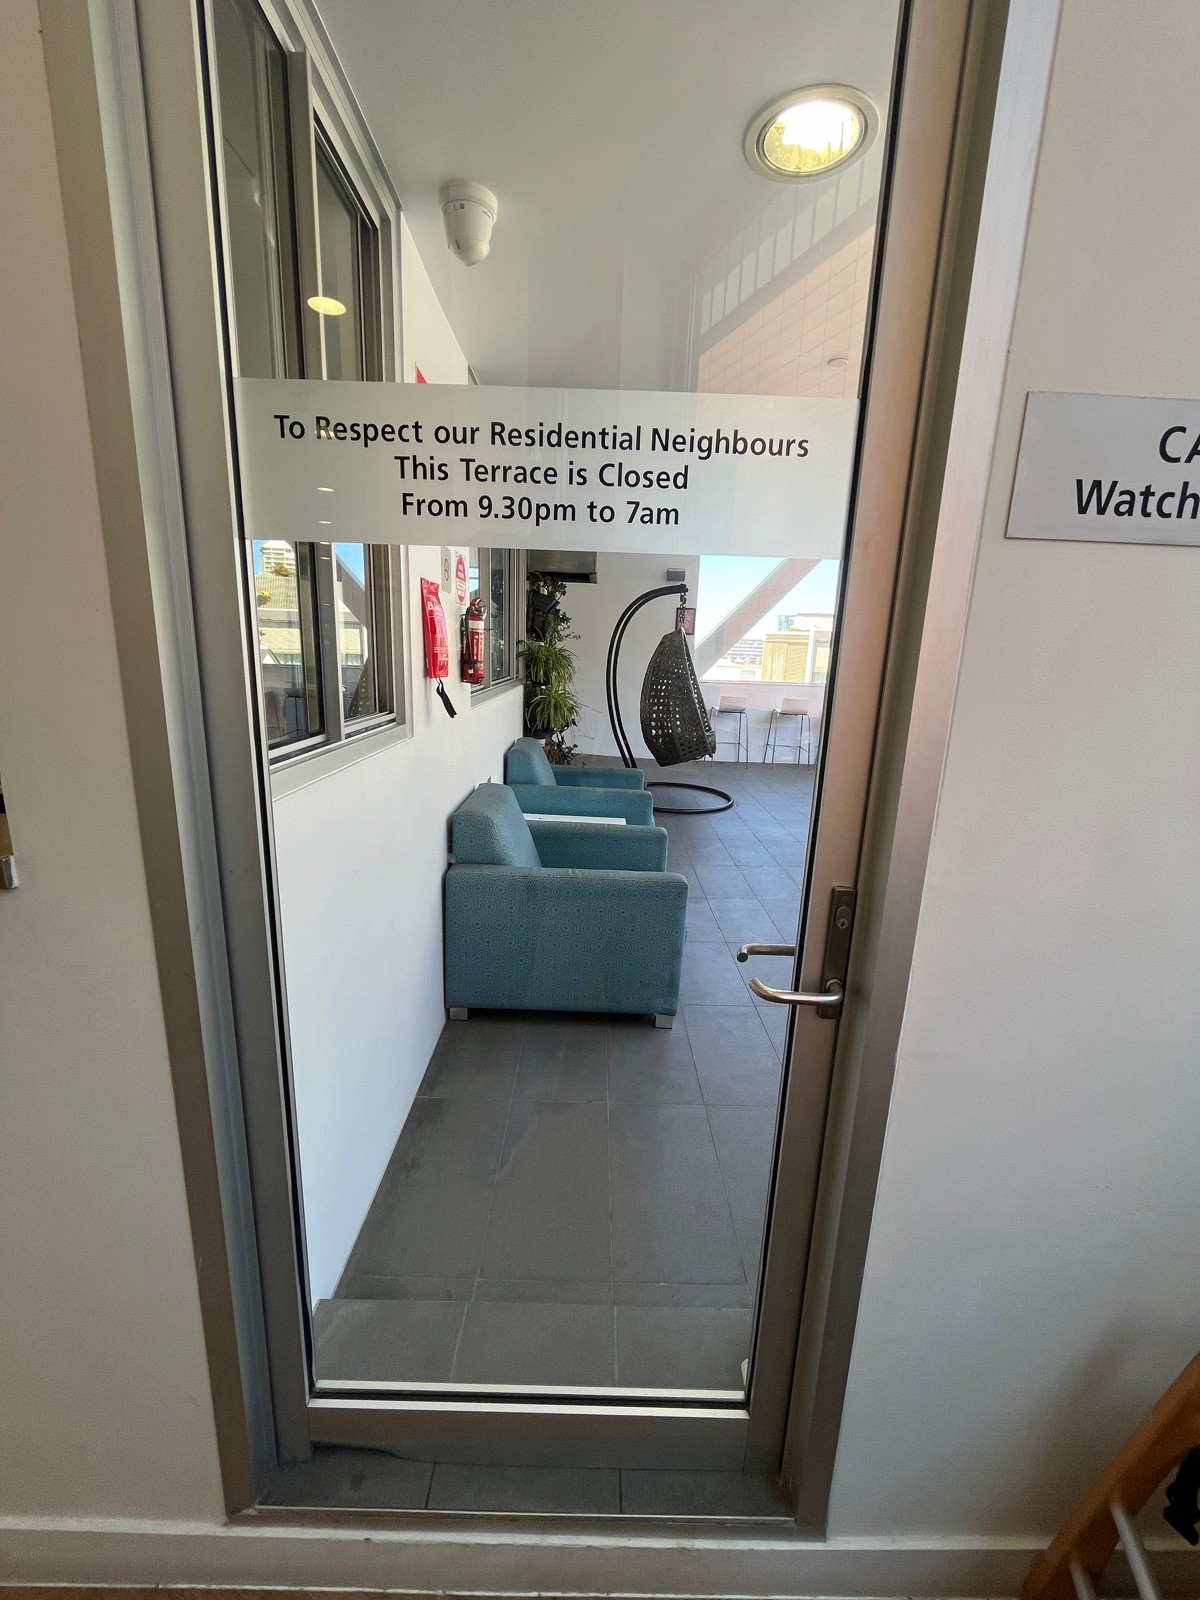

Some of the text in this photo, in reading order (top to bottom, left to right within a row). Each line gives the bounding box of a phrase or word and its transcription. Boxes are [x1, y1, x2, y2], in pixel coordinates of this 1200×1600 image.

[273, 415, 809, 459] To Respect our Residential Neighbours
[394, 455, 690, 490] This Terrace is Closed
[402, 492, 679, 527] From 9.30pm to 7am
[1075, 478, 1200, 519] Watch
